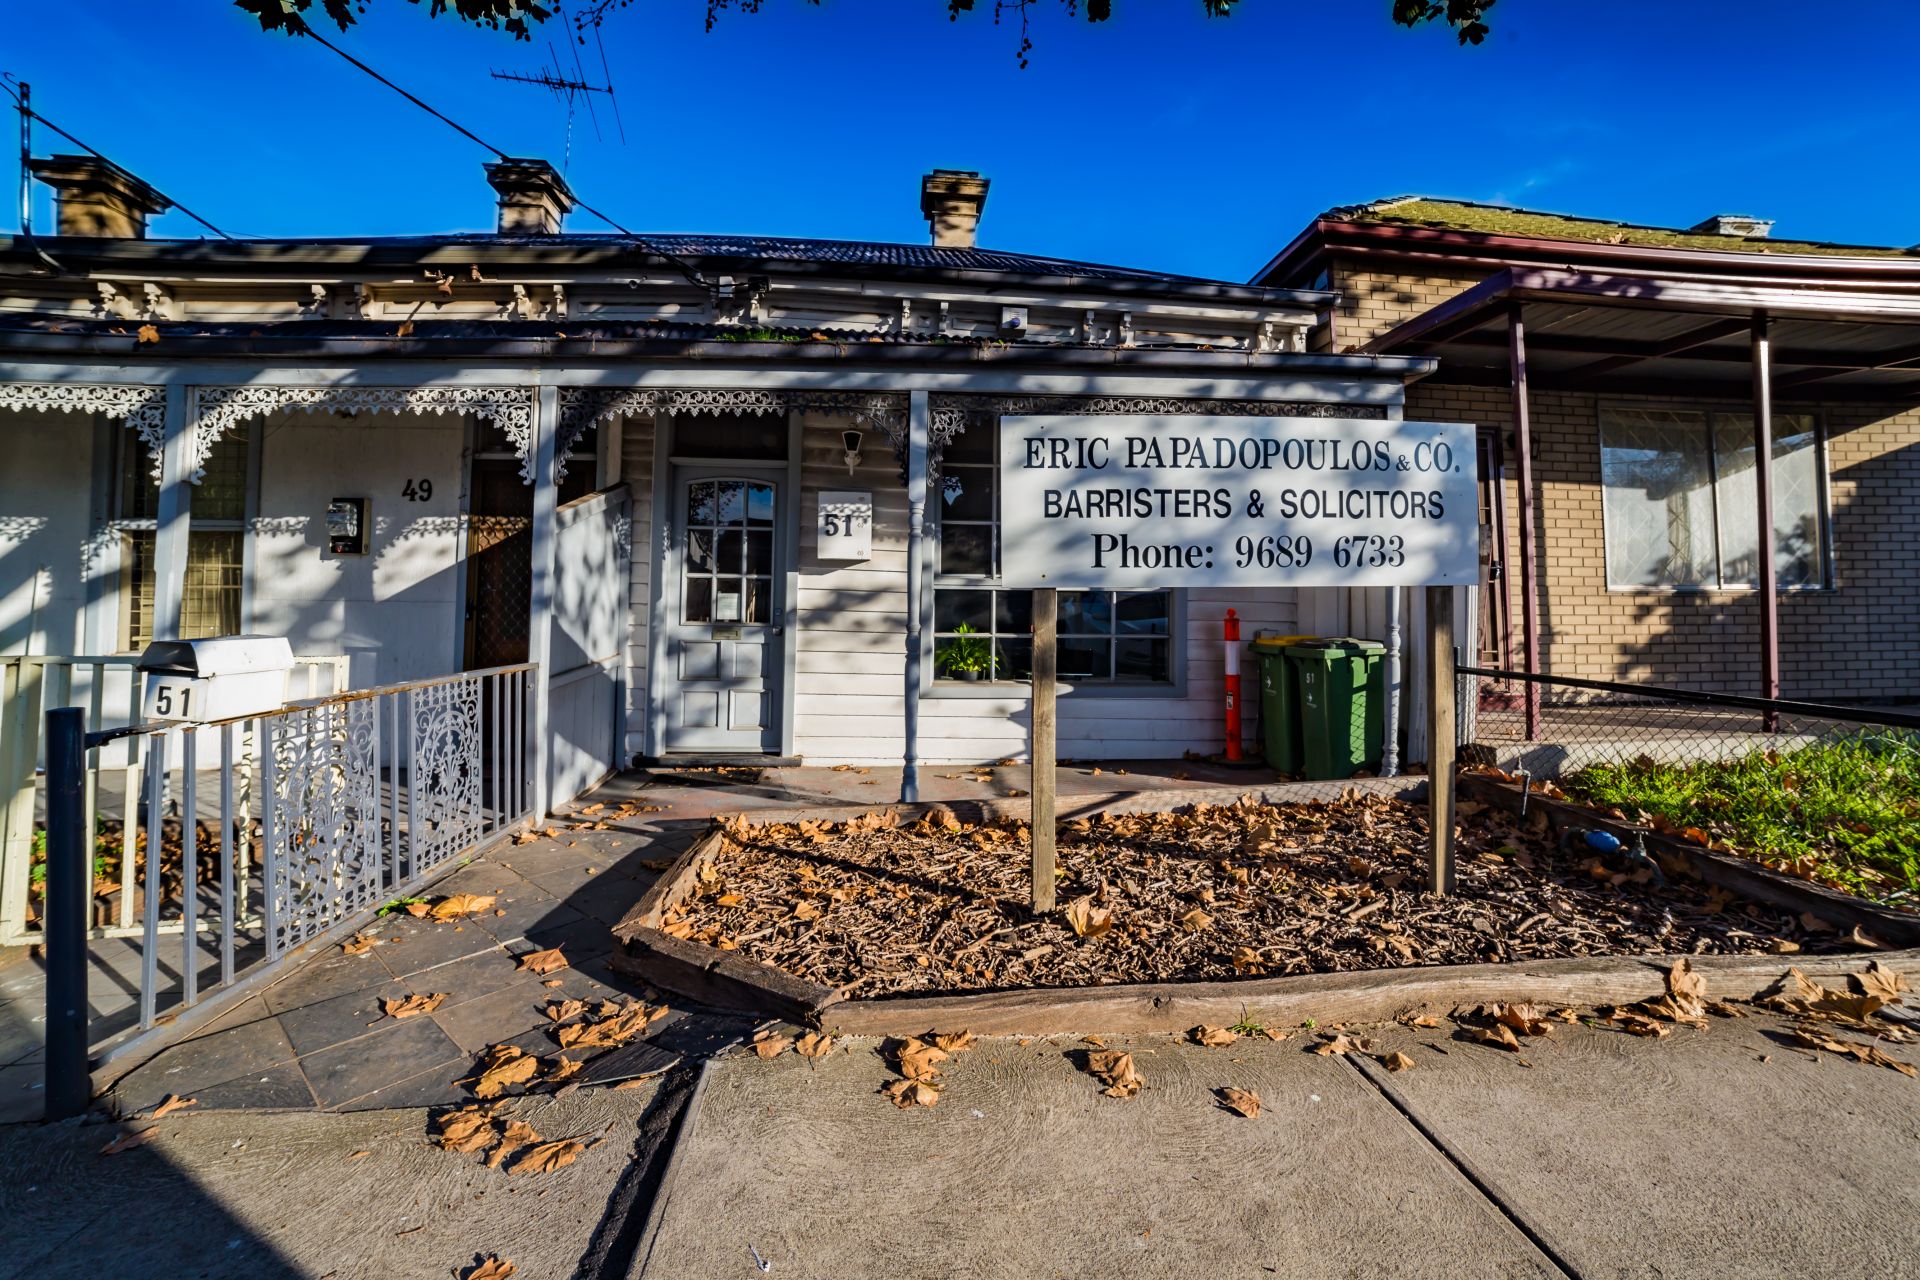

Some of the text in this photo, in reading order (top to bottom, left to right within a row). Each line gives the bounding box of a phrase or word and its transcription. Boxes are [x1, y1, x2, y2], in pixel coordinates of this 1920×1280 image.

[1023, 437, 1109, 470] ERIC
[1124, 436, 1391, 472] PAPADOPOULOS
[401, 478, 433, 502] 49
[1044, 488, 1445, 520] BARRISTERS & SOLICITORS
[824, 513, 853, 537] 51
[1090, 533, 1406, 569] Phone: 9689 6733
[156, 685, 191, 717] 51
